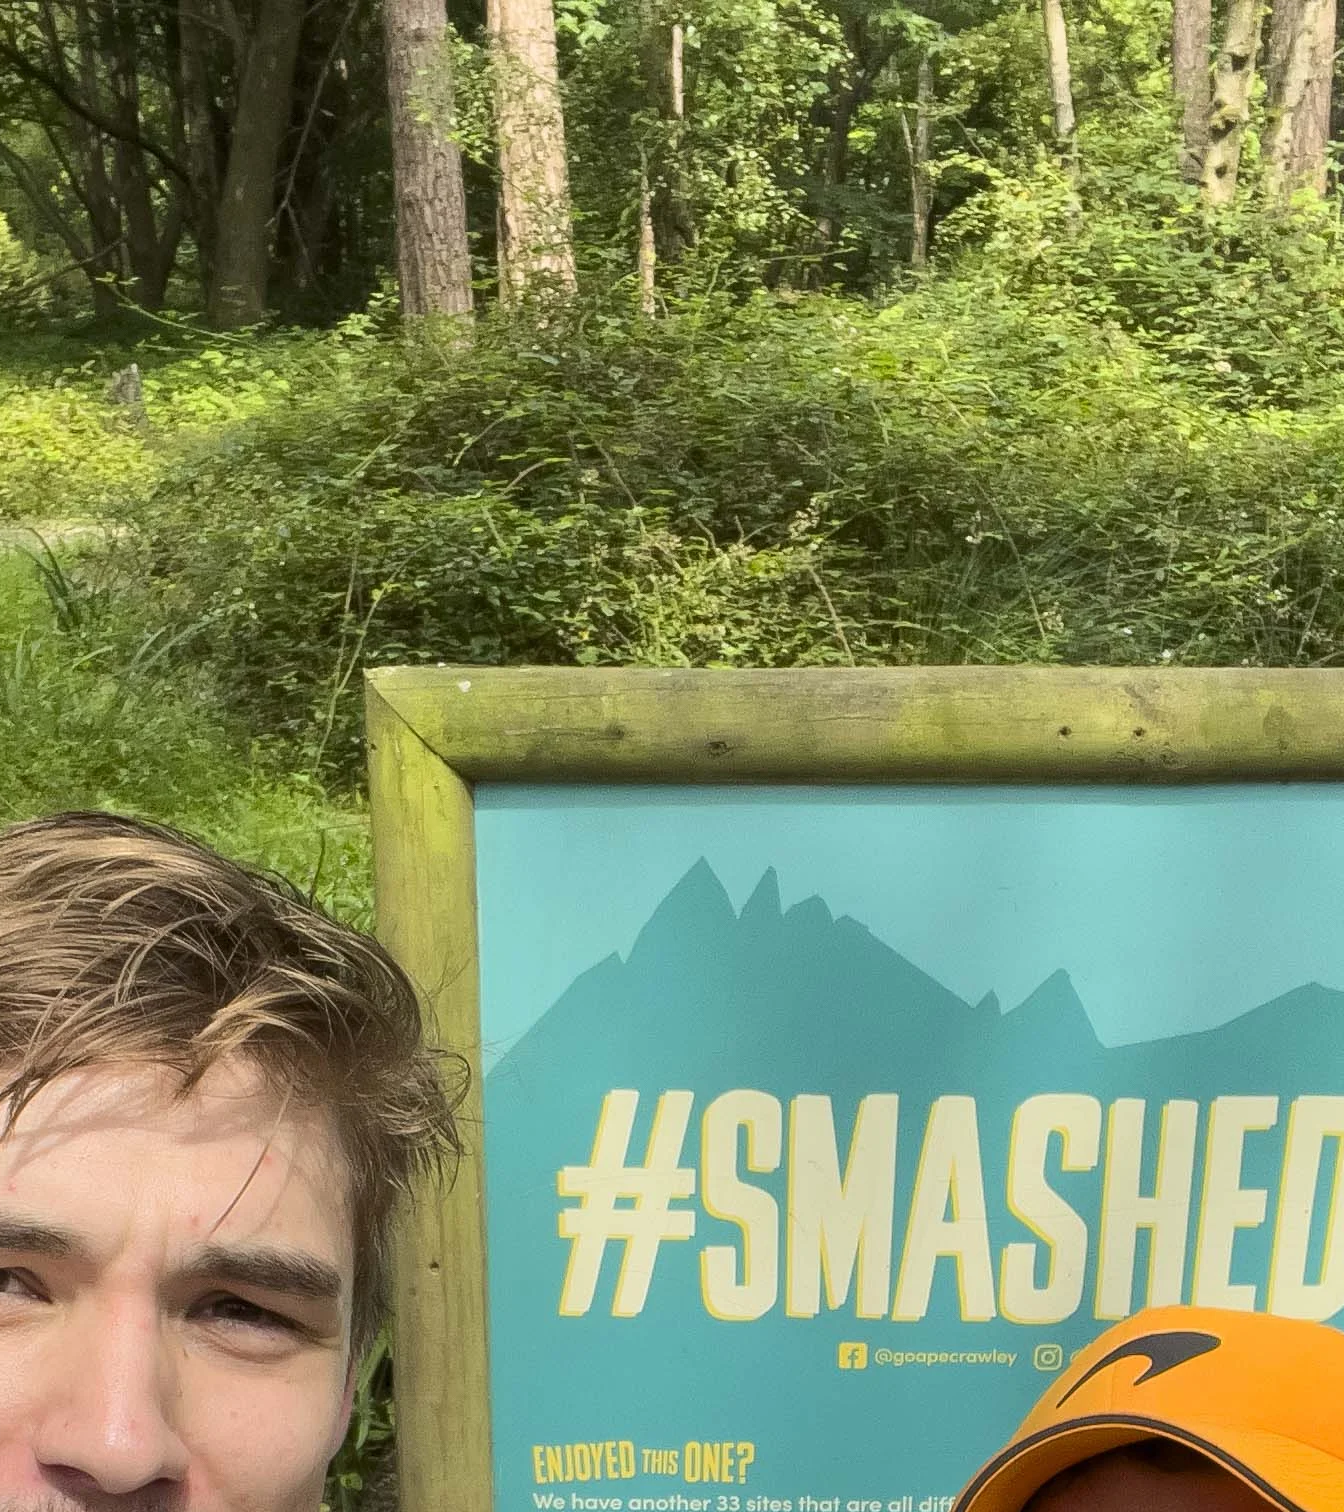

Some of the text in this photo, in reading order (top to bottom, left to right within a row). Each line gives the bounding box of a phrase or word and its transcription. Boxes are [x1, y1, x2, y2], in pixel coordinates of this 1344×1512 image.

[874, 1348, 1018, 1368] @goapecrawley
[532, 1440, 755, 1485] ENJOYED THIS ONE?
[533, 1493, 564, 1511] We
[571, 1493, 622, 1512] have
[628, 1494, 711, 1512] another
[716, 1496, 740, 1512] 33
[746, 1495, 792, 1512] sites
[798, 1495, 840, 1512] that
[846, 1499, 881, 1512] are
